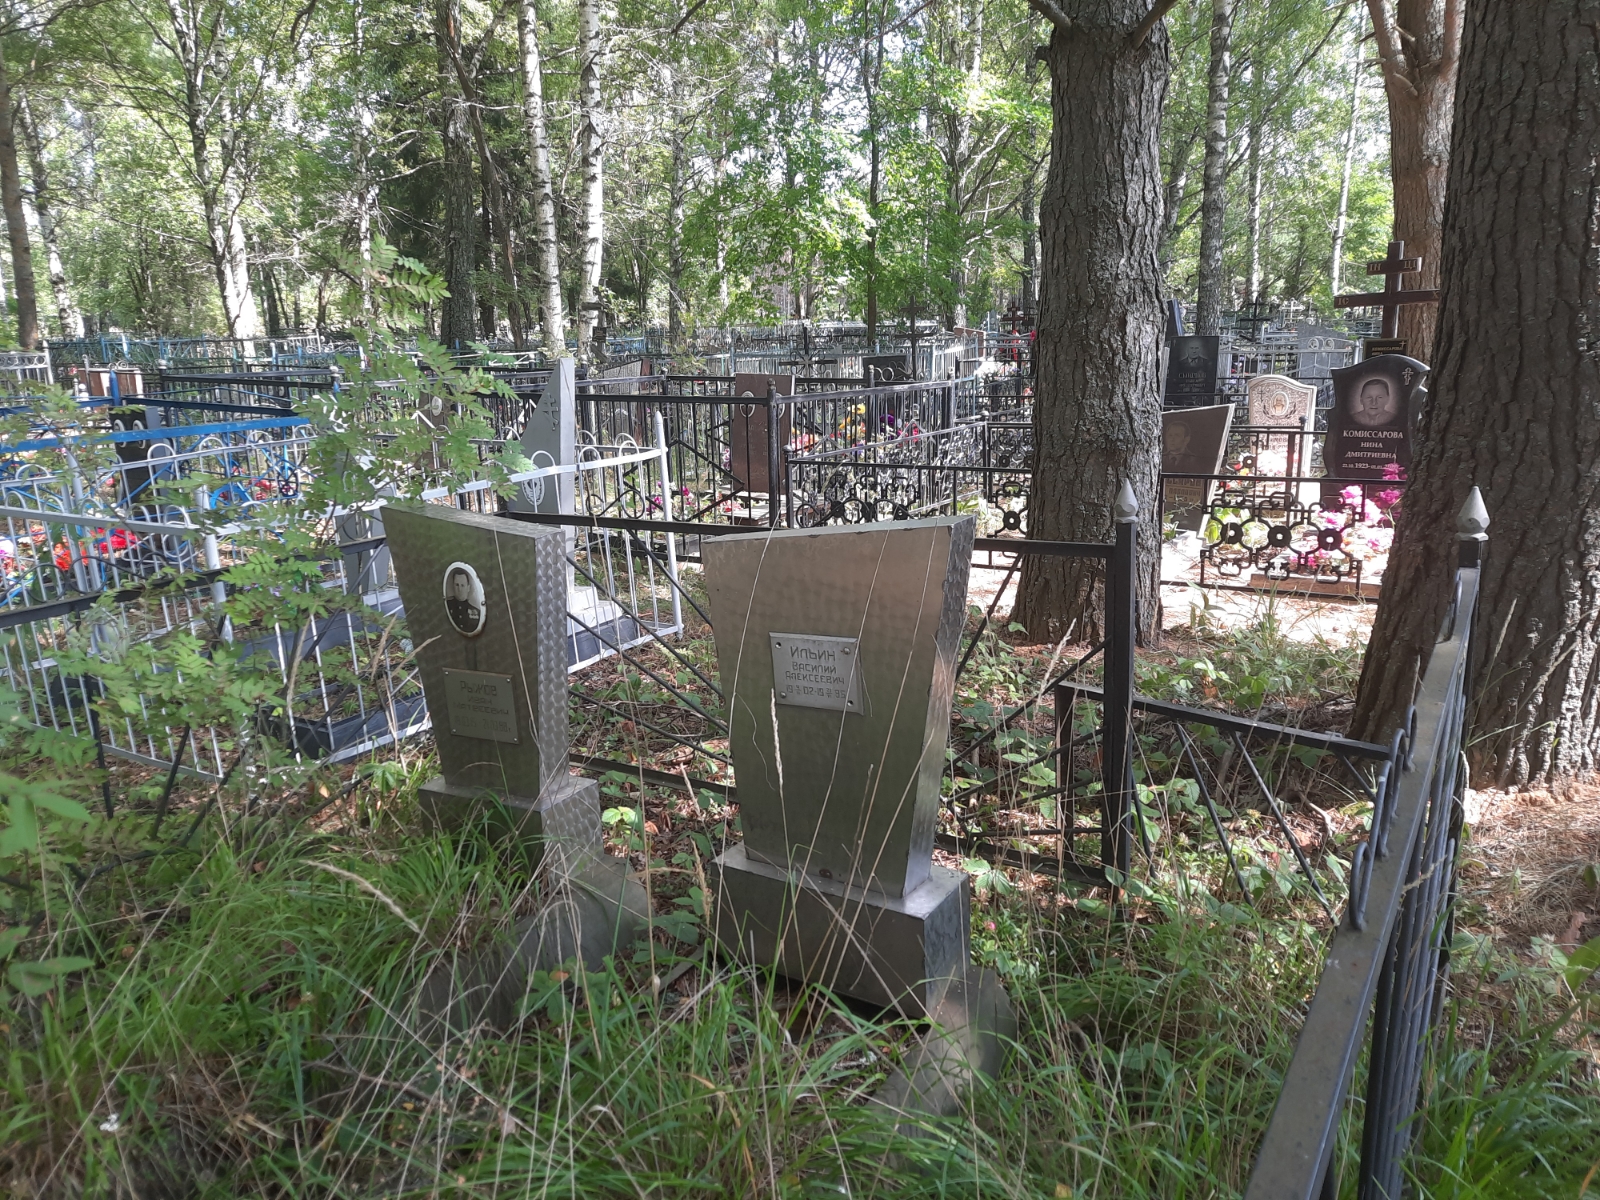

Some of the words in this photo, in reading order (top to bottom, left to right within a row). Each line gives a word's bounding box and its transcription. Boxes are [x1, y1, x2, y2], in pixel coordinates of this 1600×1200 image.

[1343, 430, 1403, 438] КОМИССАРОВА
[1345, 451, 1396, 459] ДМИТРИЕВНА
[790, 645, 836, 662] ИЛЬИН
[792, 661, 837, 675] ВАСИЛИЙ
[785, 670, 845, 685] АЛЕКСЕЕВИЧ
